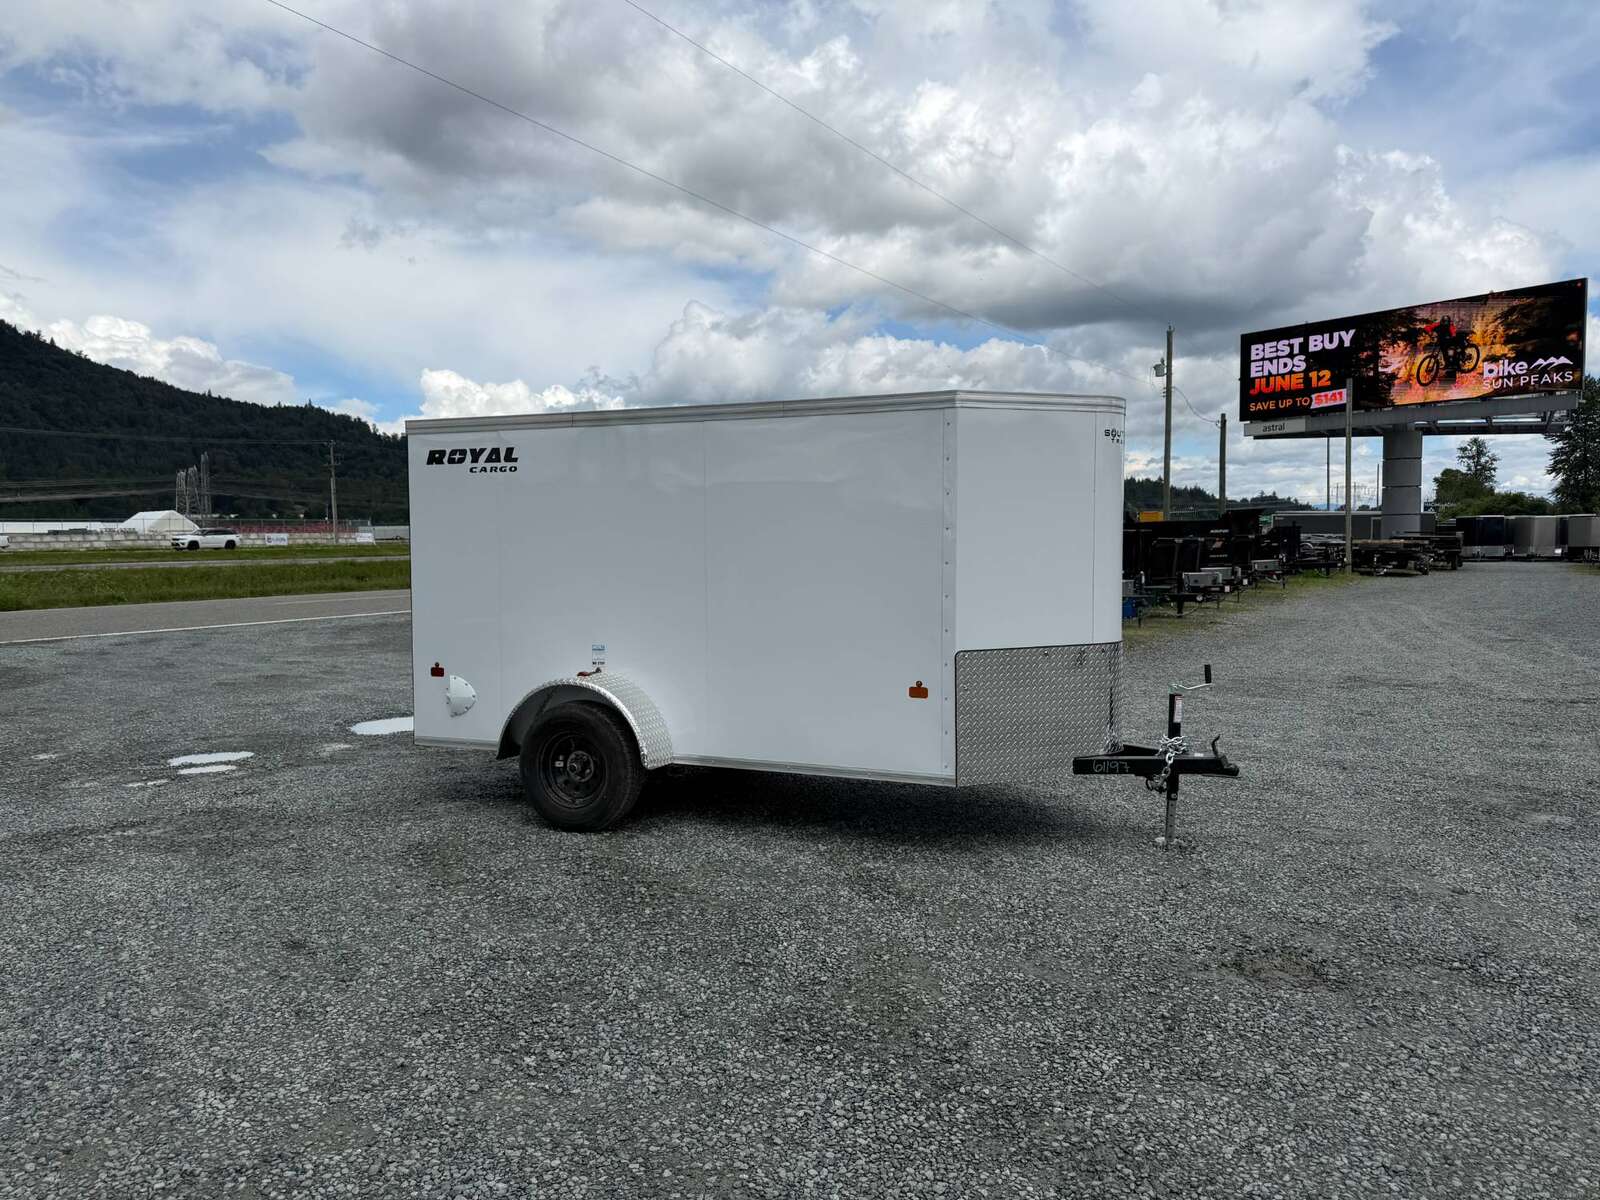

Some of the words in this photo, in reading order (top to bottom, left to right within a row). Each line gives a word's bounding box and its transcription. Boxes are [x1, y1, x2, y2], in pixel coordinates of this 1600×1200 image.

[1251, 337, 1304, 361] BEST
[1309, 329, 1356, 352] BUY
[1250, 355, 1307, 378] ENDS
[1483, 359, 1528, 378] bike
[1249, 373, 1305, 396] JUNE
[1309, 369, 1332, 388] 12
[1483, 376, 1514, 391] SUN
[1520, 371, 1573, 386] PEAKS
[1249, 400, 1277, 412] SAVE
[1279, 399, 1292, 408] UP
[1296, 396, 1311, 407] TO
[1262, 422, 1286, 433] astral
[427, 447, 518, 465] ROYAL
[469, 465, 518, 474] CARGO
[1093, 760, 1130, 772] 61197
